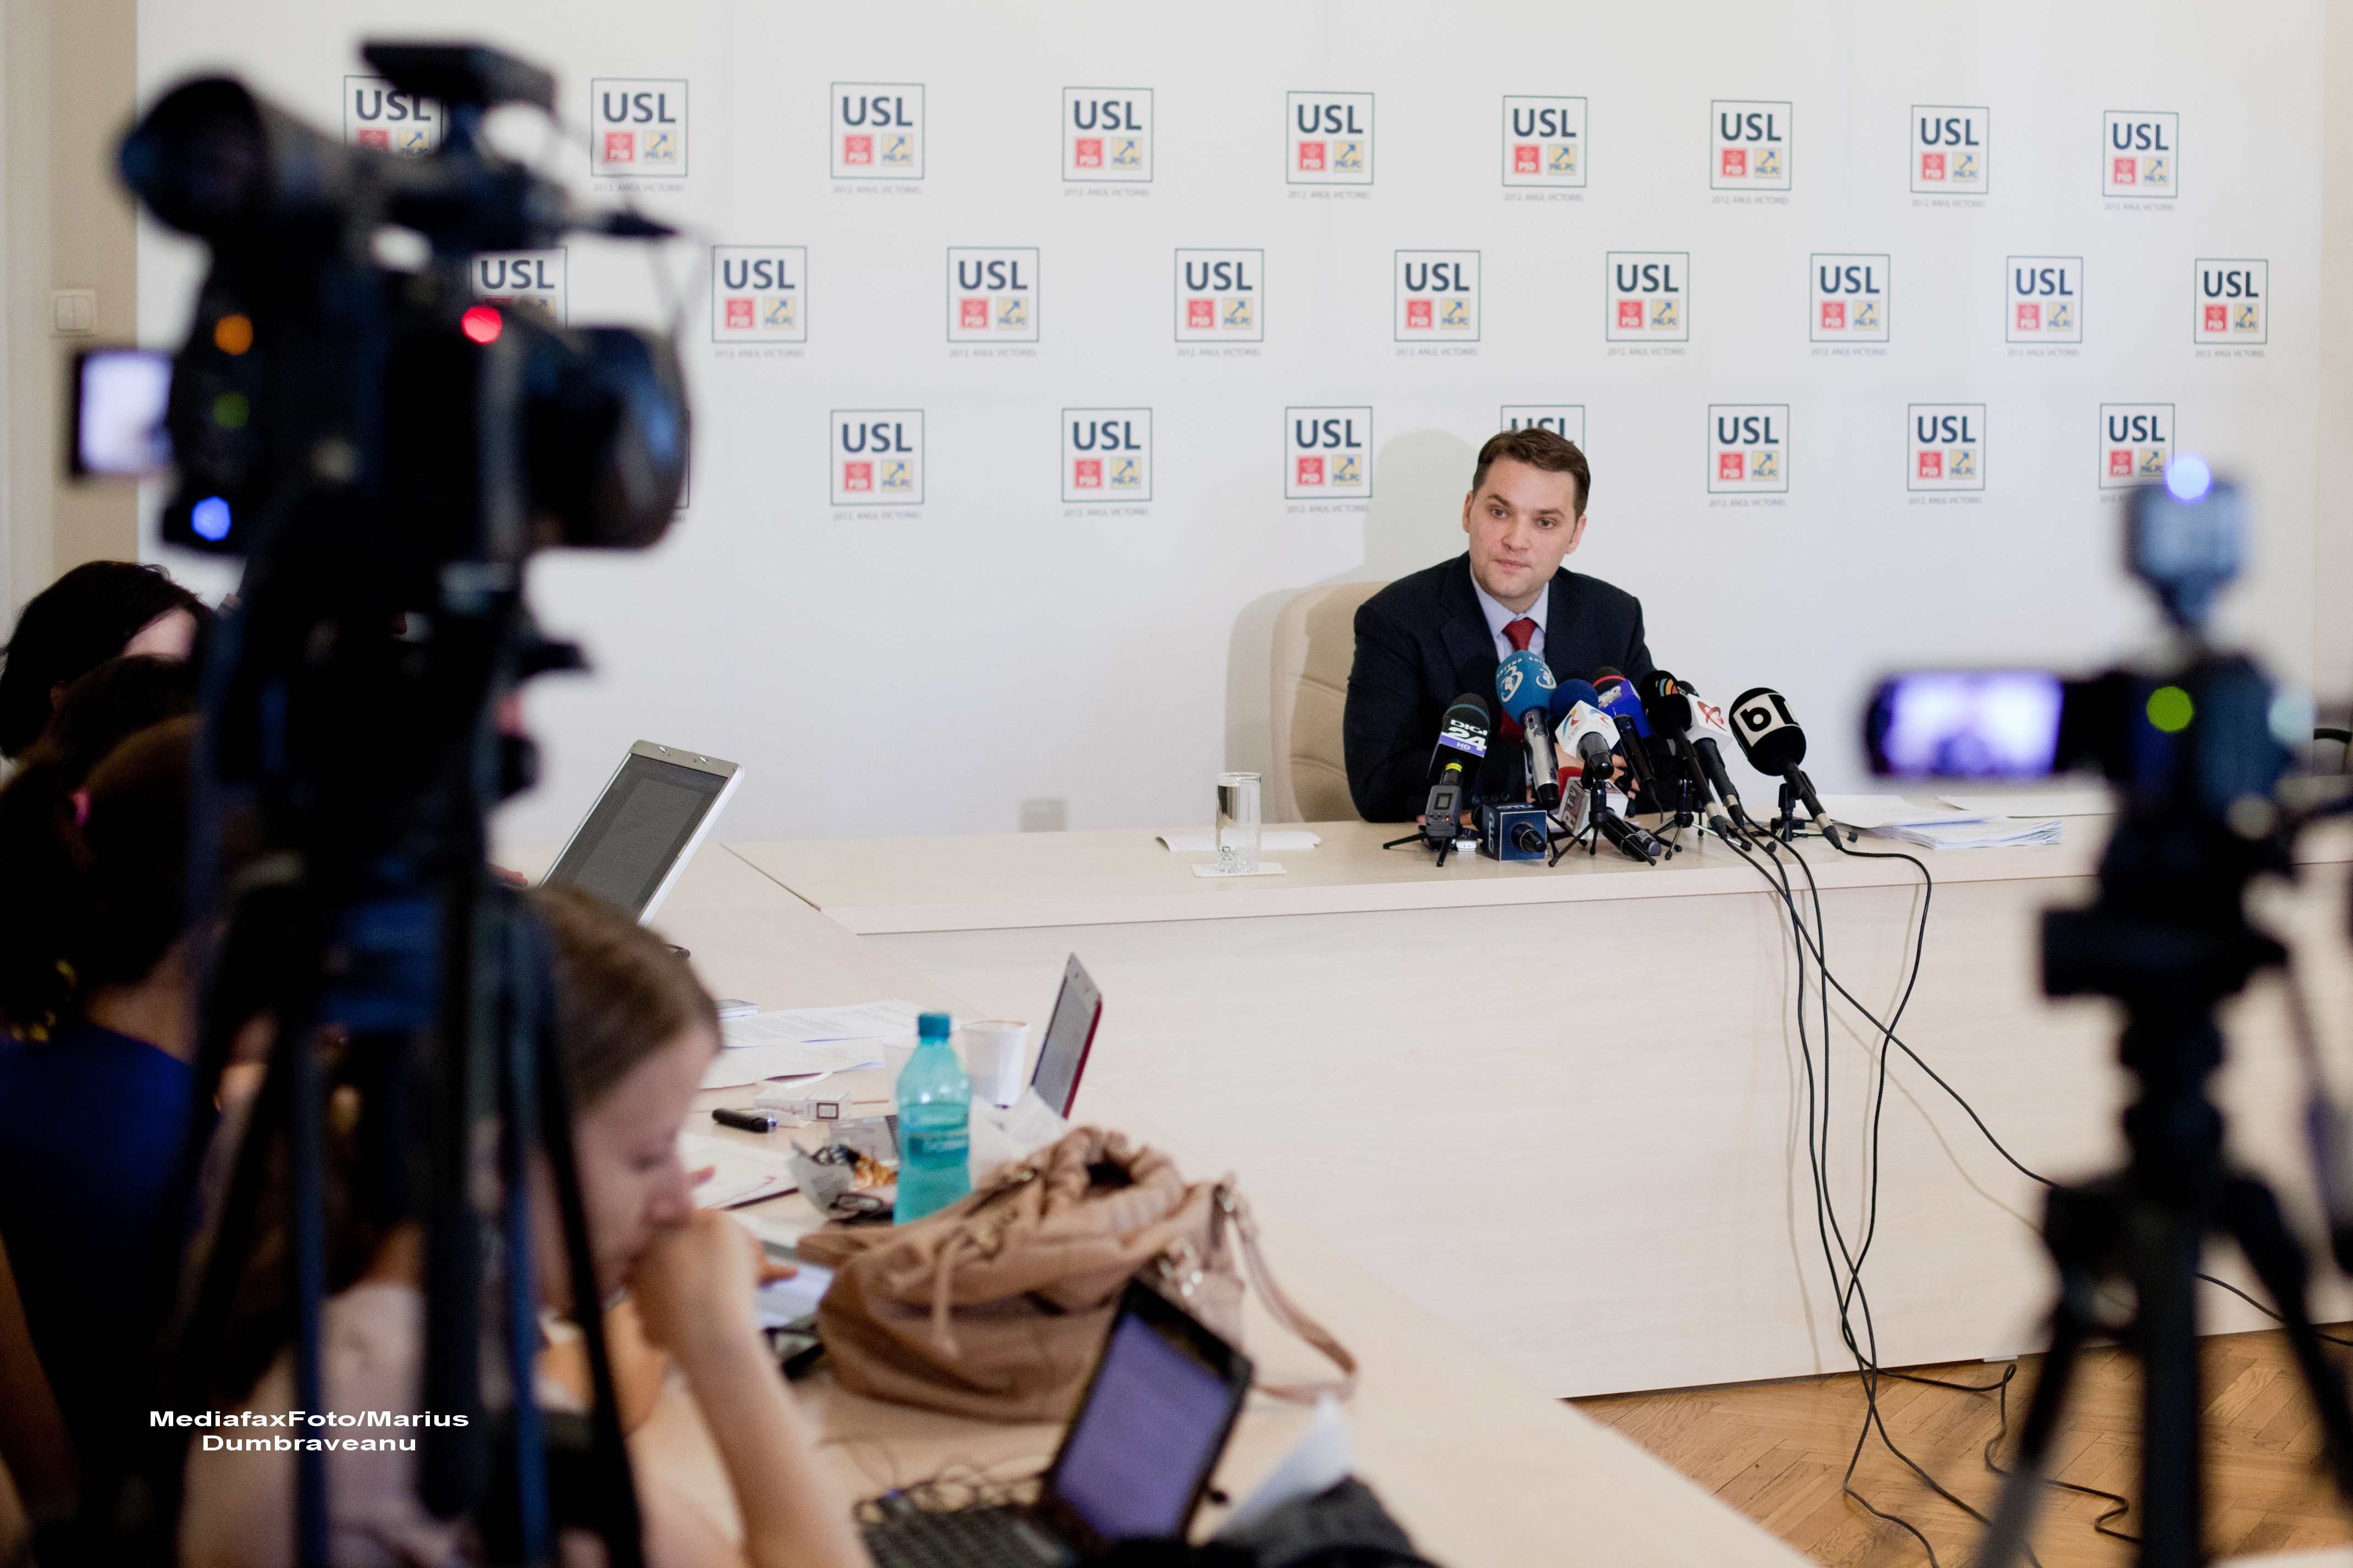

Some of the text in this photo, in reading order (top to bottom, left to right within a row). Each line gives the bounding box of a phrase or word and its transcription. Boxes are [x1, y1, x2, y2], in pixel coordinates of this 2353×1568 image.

[356, 90, 431, 121] USL
[603, 92, 676, 123] USL
[843, 96, 913, 126] USL
[1074, 100, 1141, 130] USL
[1297, 104, 1363, 134] USL
[1514, 108, 1576, 137] USL
[1721, 113, 1781, 141] USL
[1921, 118, 1979, 146] USL
[2113, 123, 2169, 150] USL
[481, 259, 554, 289] USL
[723, 259, 794, 290] USL
[959, 261, 1028, 290] USL
[1186, 262, 1252, 291] USL
[1405, 263, 1470, 291] USL
[1617, 264, 1678, 292] USL
[1820, 266, 1880, 293] USL
[2016, 268, 2073, 295] USL
[2204, 271, 2258, 297] USL
[842, 422, 912, 453] USL
[1073, 420, 1141, 451] USL
[1296, 419, 1361, 448] USL
[1719, 416, 1778, 444] USL
[1918, 415, 1975, 443] USL
[2109, 415, 2165, 442] USL
[1441, 727, 1487, 752] 24
[1450, 719, 1488, 736] DIGI
[1567, 725, 1579, 740] TVR
[1456, 741, 1471, 750] HD
